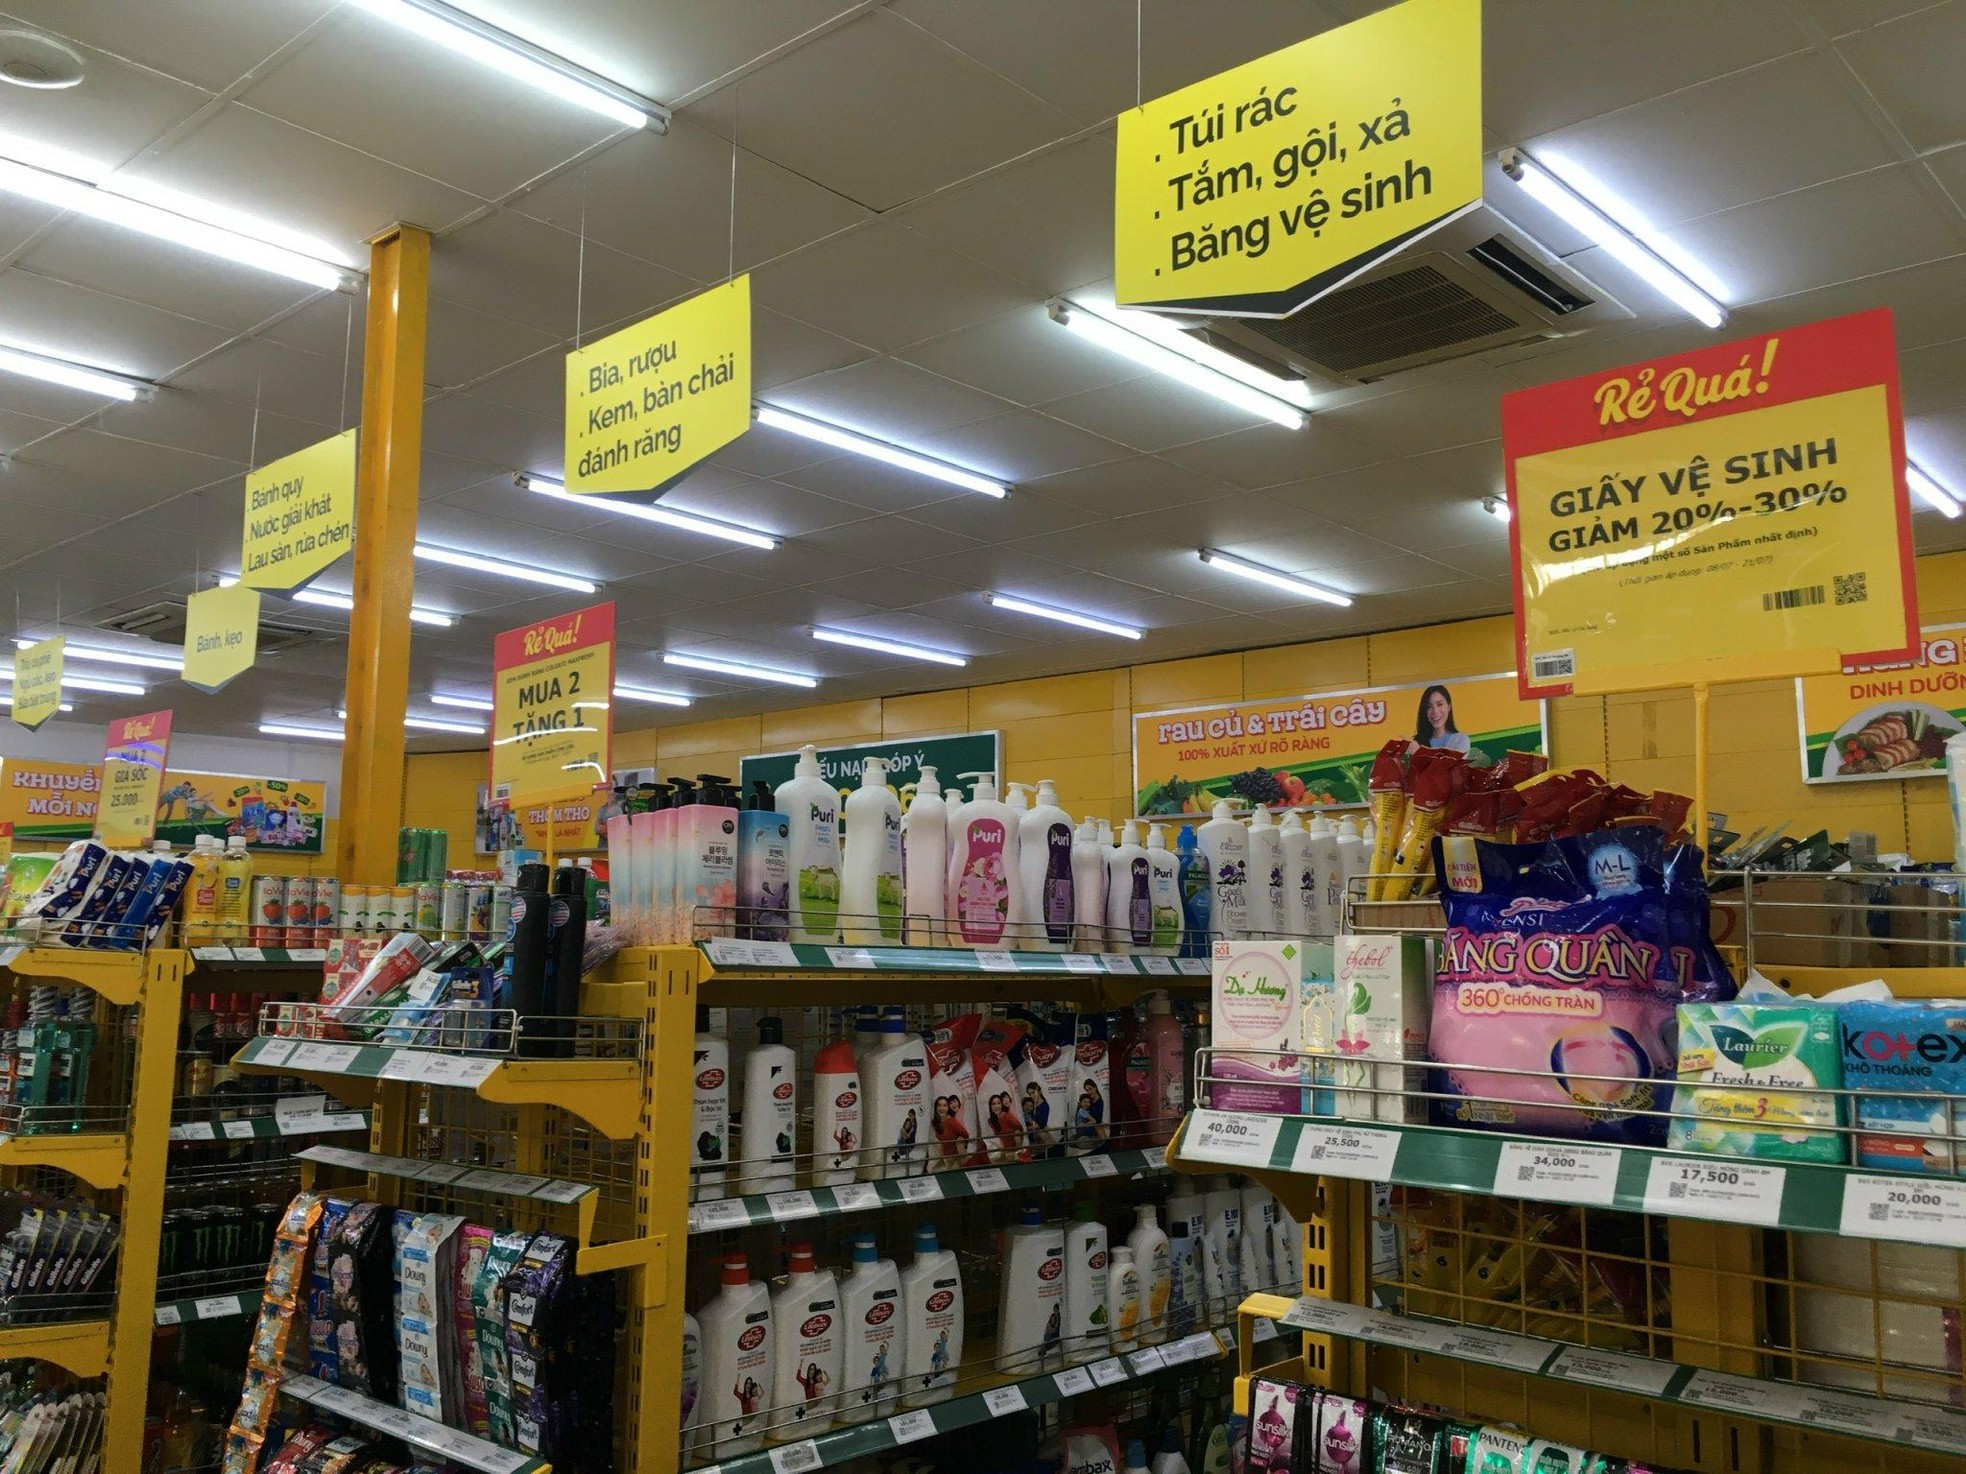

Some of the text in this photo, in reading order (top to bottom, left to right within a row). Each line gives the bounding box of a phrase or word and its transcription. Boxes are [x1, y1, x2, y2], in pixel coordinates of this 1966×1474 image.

[1169, 86, 1297, 154] Túi rác
[1169, 97, 1410, 212] Tắm, gội, xả
[1172, 159, 1431, 271] Băng vệ sinh
[589, 340, 677, 394] Bia, rượu
[1594, 338, 1779, 426] Rẻ Quá!
[589, 353, 734, 434] Kem, bàn chải
[578, 424, 681, 477] đánh răng
[282, 475, 304, 501] quy
[1550, 437, 1838, 518] GIẤY VỆ SINH
[1549, 515, 1638, 552] GIẢM
[248, 552, 268, 572] Lau
[519, 671, 580, 709] MUA 2
[1850, 680, 1903, 700] DINH
[573, 706, 584, 728] 1
[1178, 748, 1210, 762] 100%
[1213, 741, 1246, 758] XUẤT
[1270, 736, 1290, 752] RÕ
[1292, 735, 1331, 751] RÀNG
[811, 807, 834, 823] Puri
[972, 827, 1001, 843] Puri
[1155, 866, 1173, 878] Puri
[1595, 854, 1631, 875] M-L
[1504, 989, 1551, 1008] CHỐNG
[1556, 992, 1595, 1010] TRÀN
[1724, 1038, 1789, 1055] Laurier
[1873, 1062, 1933, 1077] THOÁNG
[1207, 1122, 1248, 1136] 40,000
[1324, 1136, 1360, 1147] 25,500
[1533, 1156, 1575, 1167] 34,000
[1680, 1168, 1739, 1184] 17,500
[1887, 1192, 1942, 1206] 20,000
[1255, 1421, 1291, 1440] sunsilk
